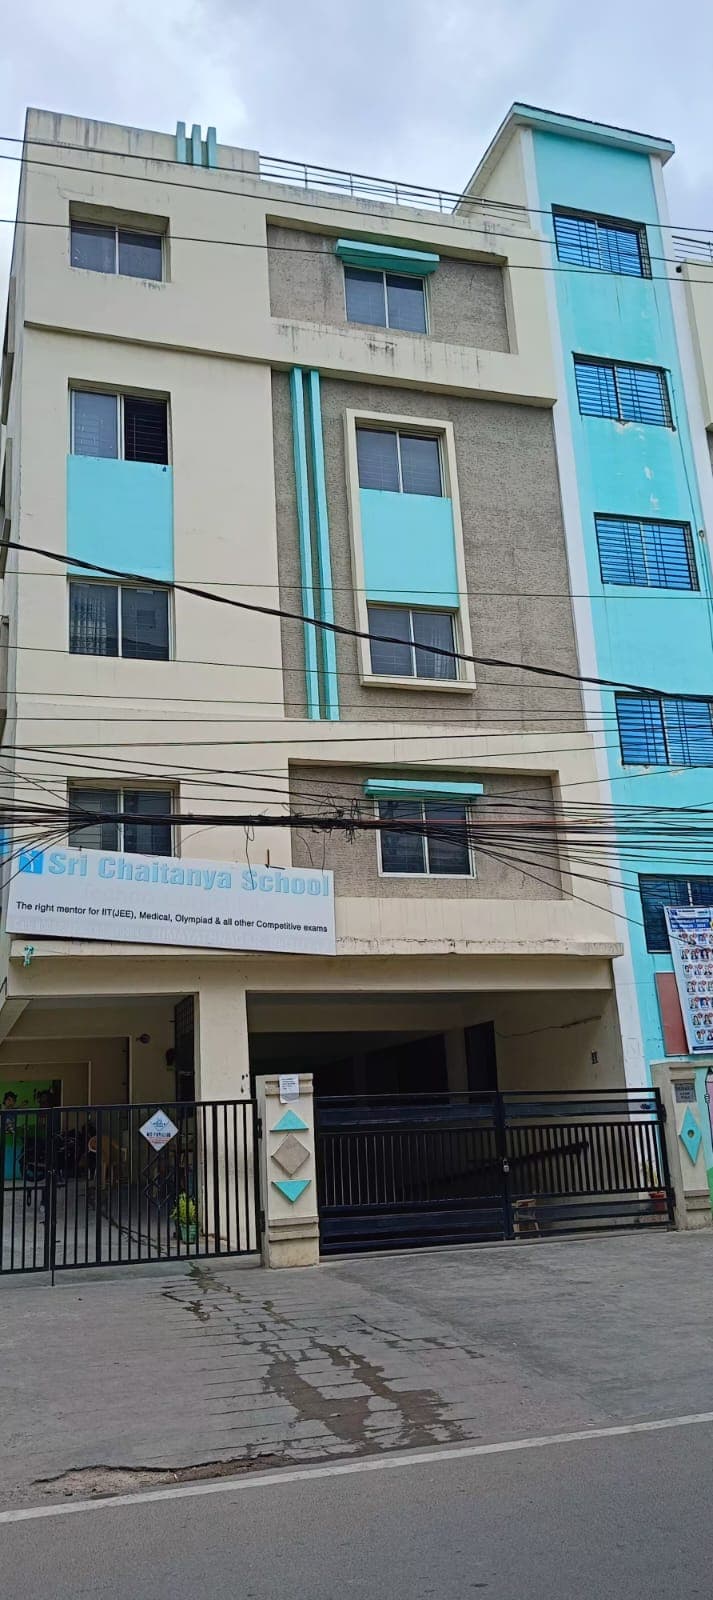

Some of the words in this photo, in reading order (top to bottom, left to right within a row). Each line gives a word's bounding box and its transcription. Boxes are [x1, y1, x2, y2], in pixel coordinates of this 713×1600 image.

[48, 852, 87, 876] Sri
[98, 855, 232, 890] Chaitanya
[241, 869, 329, 896] School
[16, 901, 33, 910] The
[35, 903, 54, 913] right
[56, 905, 86, 915] mentor
[88, 907, 99, 916] for
[102, 909, 137, 920] IIT(JEE),
[139, 911, 173, 922] Medical,
[175, 914, 213, 925] Olympiad
[215, 917, 221, 925] &
[223, 918, 232, 926] all
[234, 919, 254, 927] other
[256, 920, 301, 931] Competitive
[303, 924, 328, 933] exams
